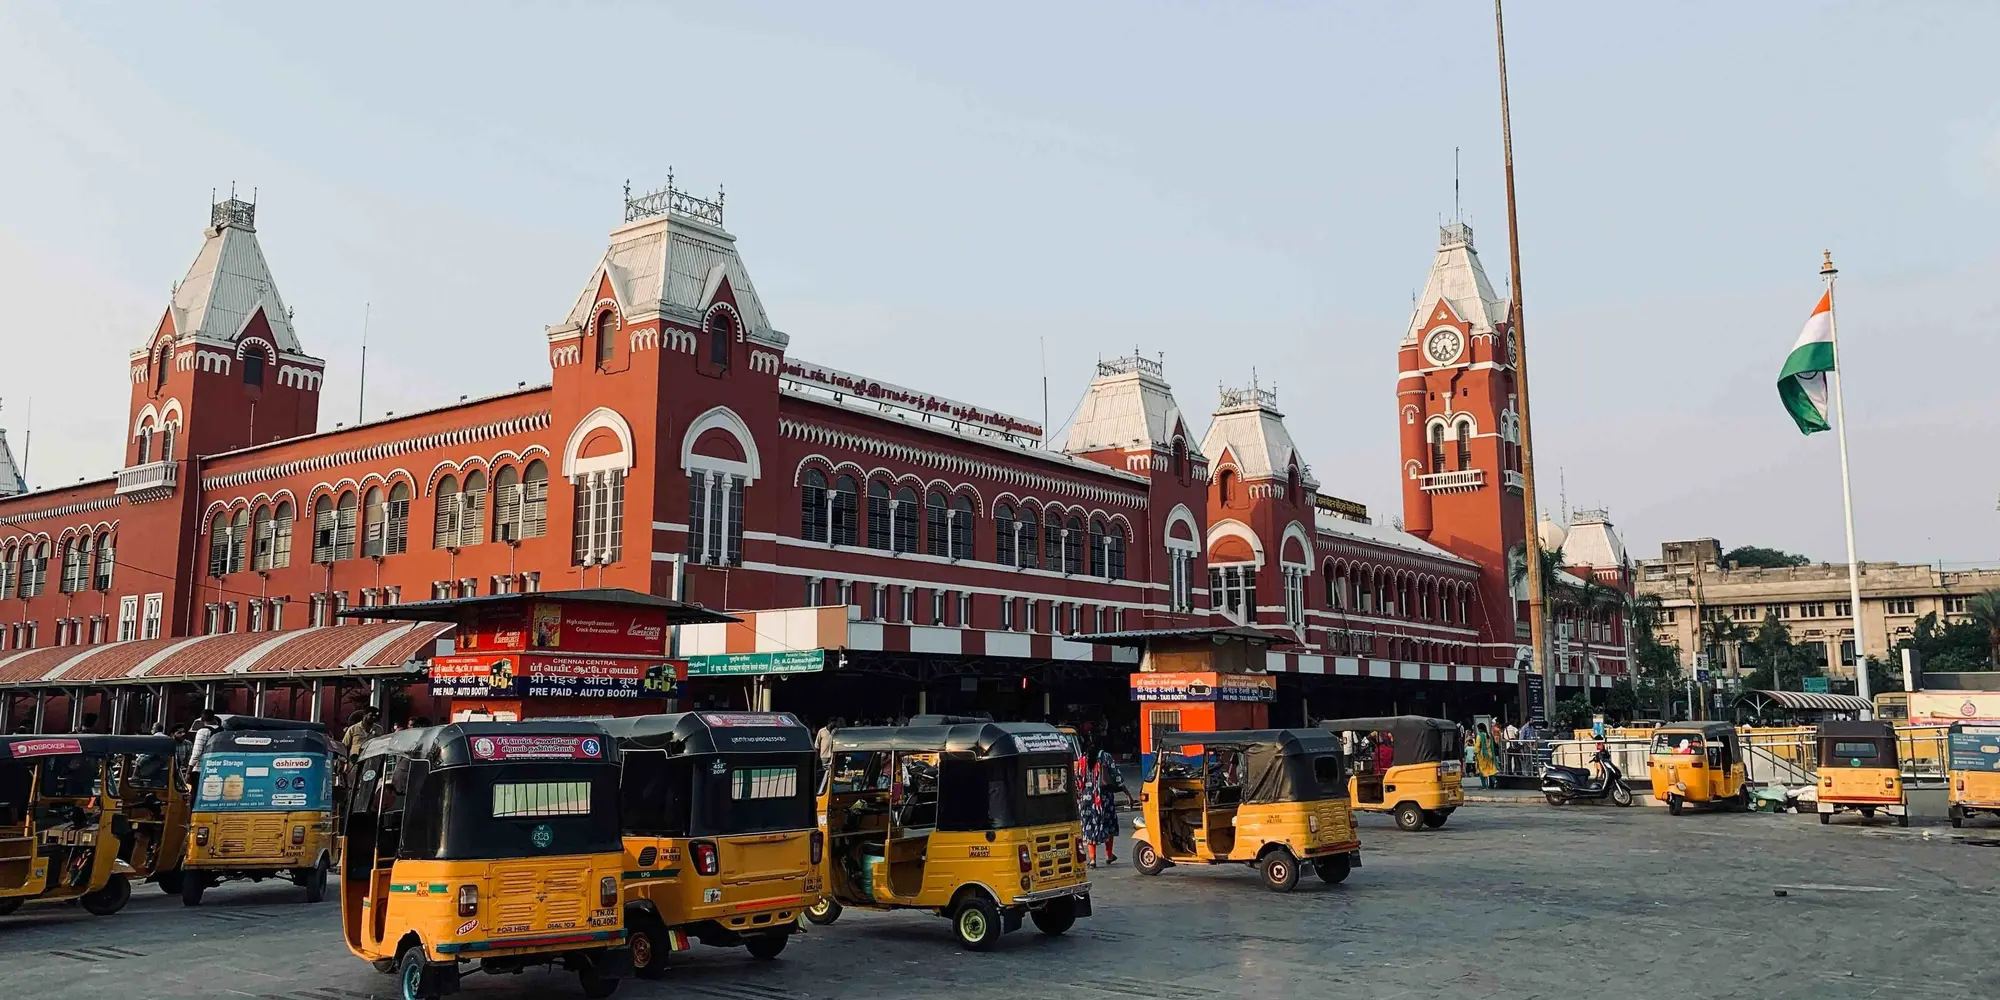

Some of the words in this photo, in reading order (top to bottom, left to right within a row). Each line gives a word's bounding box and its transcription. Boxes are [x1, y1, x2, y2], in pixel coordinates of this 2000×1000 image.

[552, 657, 585, 665] CHENNAI
[585, 658, 618, 666] CENTRAL
[530, 672, 577, 686] प्री-पेइड
[583, 674, 613, 686] ऑटो
[619, 677, 638, 689] बूथ
[433, 687, 442, 696] PRE
[443, 687, 454, 696] PAID
[457, 687, 470, 696] AUTO
[471, 687, 488, 696] BOOTH
[529, 687, 548, 697] PRE
[550, 687, 572, 697] PAID
[580, 688, 605, 698] AUTO
[606, 689, 638, 698] BOOTH
[28, 743, 65, 751] NOBROKER
[206, 759, 222, 767] Water
[223, 759, 244, 768] Storage
[275, 759, 310, 768] ashirvad
[206, 766, 218, 774] Tank
[595, 909, 615, 917] TN.02
[458, 920, 478, 935] STOP
